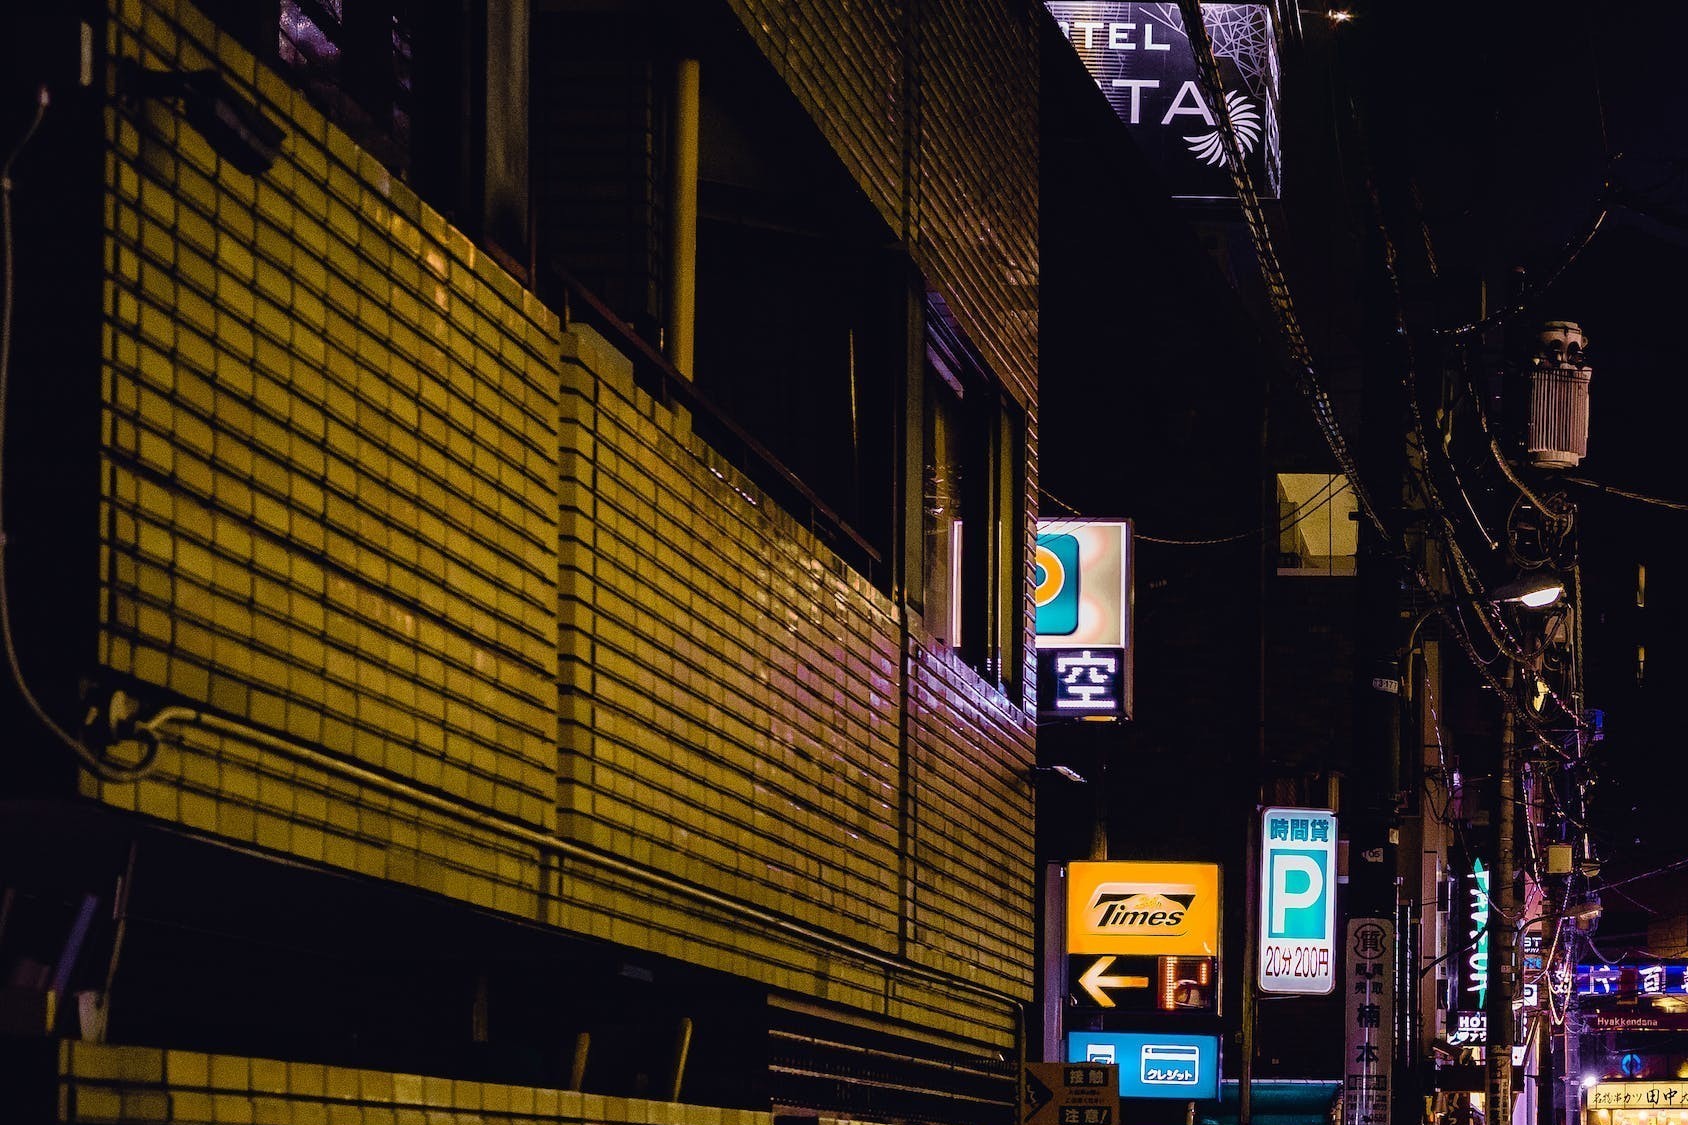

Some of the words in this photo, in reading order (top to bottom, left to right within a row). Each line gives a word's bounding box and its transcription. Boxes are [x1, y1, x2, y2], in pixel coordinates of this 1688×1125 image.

[1057, 650, 1116, 708] 空
[1270, 818, 1329, 843] 時間貸
[1272, 854, 1324, 934] P
[1097, 903, 1184, 928] Times
[1460, 1016, 1487, 1028] HOT
[1146, 1069, 1193, 1082] クレジット
[1646, 1087, 1678, 1106] 田中
